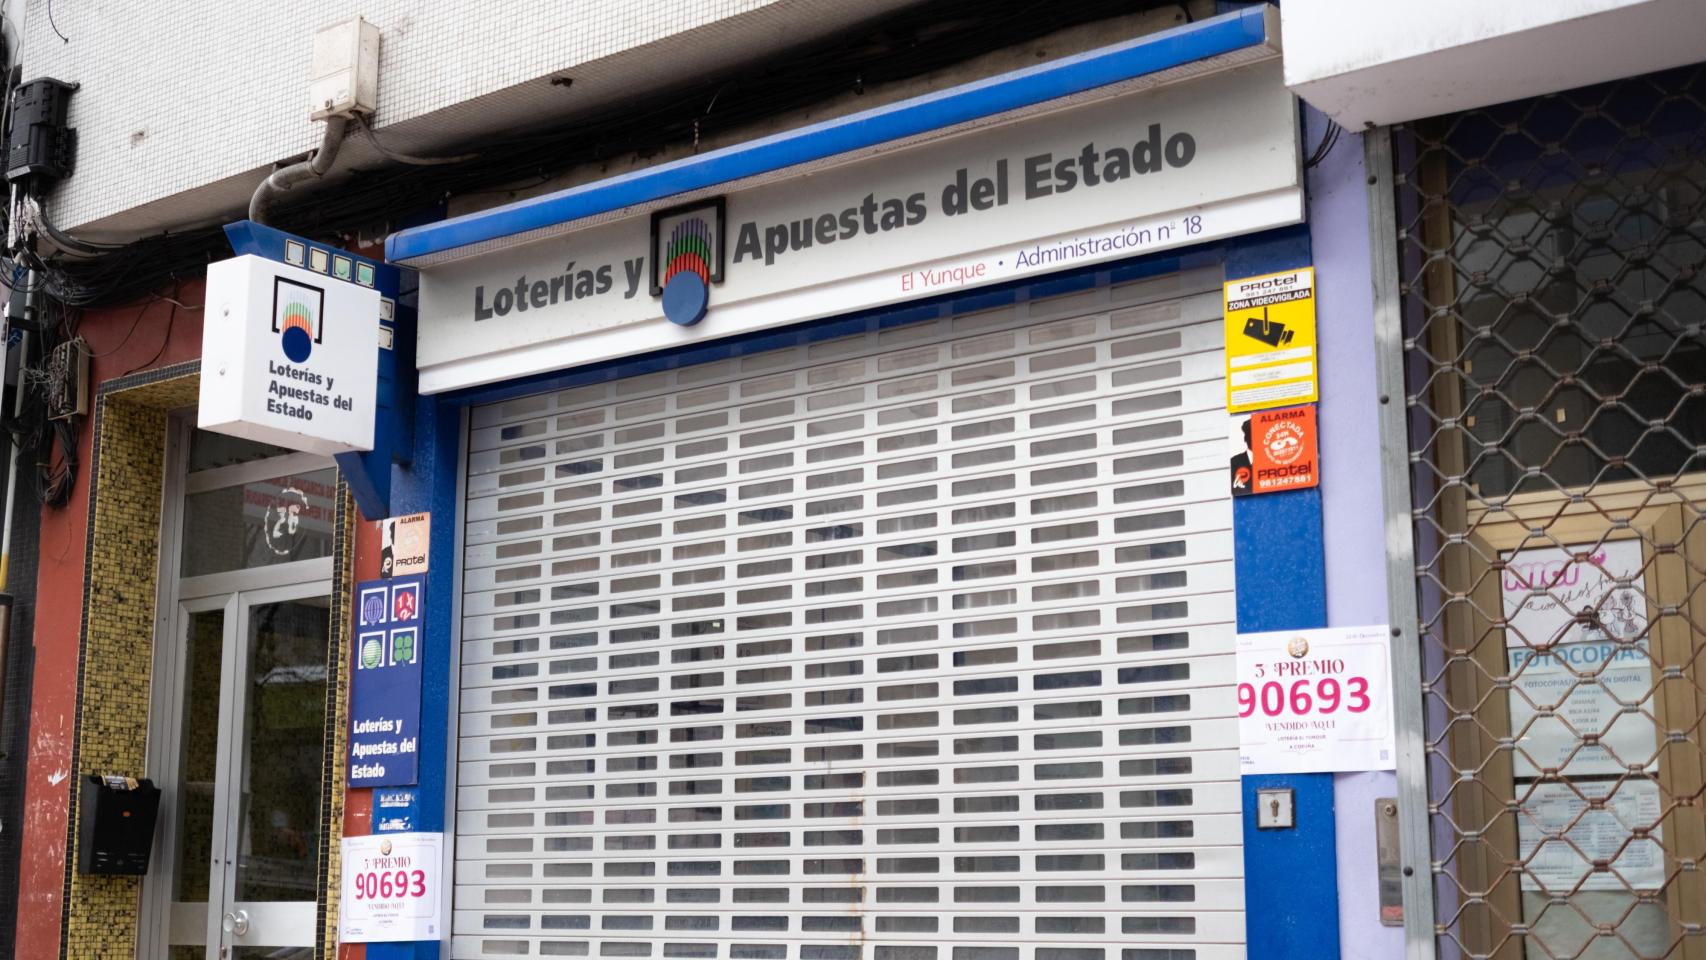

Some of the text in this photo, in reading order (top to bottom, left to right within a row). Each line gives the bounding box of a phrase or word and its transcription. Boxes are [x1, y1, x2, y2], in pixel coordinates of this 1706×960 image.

[474, 123, 1197, 322] Loterías y Apuestas del Estado
[1015, 224, 1151, 269] Administración
[1182, 215, 1203, 236] 18
[901, 262, 986, 292] El Yunque
[1228, 290, 1311, 311] ZONA VIDEOVIGILADA
[269, 359, 334, 391] Loterías y
[268, 379, 353, 412] Apuestas del
[267, 398, 313, 421] Estado
[1260, 410, 1306, 422] ALARMA
[1263, 421, 1304, 446] CONECTADA
[399, 515, 425, 524] ALARMA
[1513, 643, 1647, 668] FOTOCOPIAS
[1273, 658, 1345, 678] PREMIO
[1612, 674, 1642, 684] DIGITAL
[1237, 676, 1371, 719] 90693
[353, 716, 403, 735] Loterías y
[1265, 721, 1308, 732] VENDIDO
[352, 737, 416, 760] Apuestas del
[351, 763, 385, 779] Estado
[373, 856, 411, 870] PREMIO
[355, 869, 426, 900] 90693
